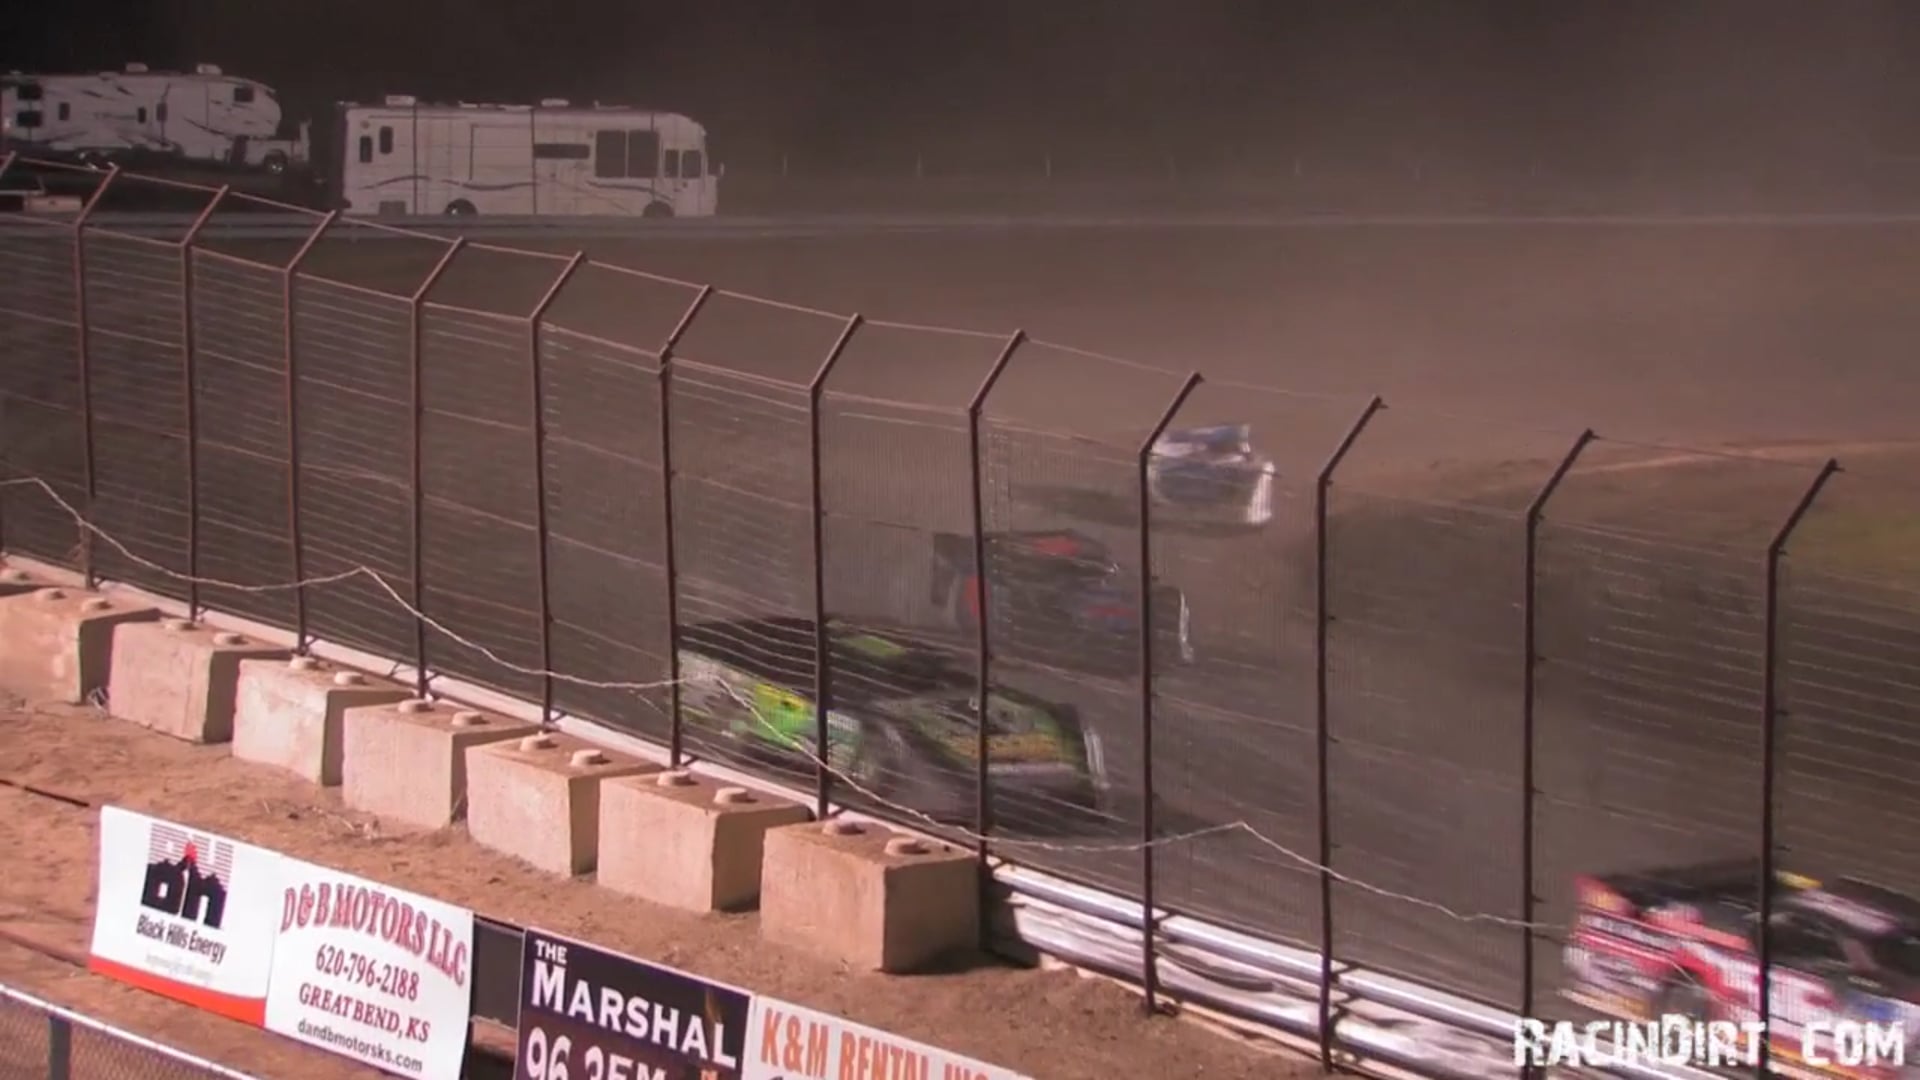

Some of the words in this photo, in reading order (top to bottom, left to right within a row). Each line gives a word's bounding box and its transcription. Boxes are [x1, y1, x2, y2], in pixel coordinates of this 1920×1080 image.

[136, 914, 167, 943] Black
[165, 922, 190, 950] Hills
[188, 930, 228, 966] Energy
[329, 882, 428, 957] MOTORS
[425, 919, 468, 988] LLC
[534, 939, 568, 965] THE
[315, 942, 421, 1003] 620-796-2188
[299, 982, 354, 1019] GREAT
[352, 999, 404, 1039] BEND,
[405, 1015, 431, 1044] KS
[531, 959, 737, 1070] MARSHAL
[760, 1007, 830, 1079] K&M
[297, 1018, 424, 1073] dandbmotorsks.com
